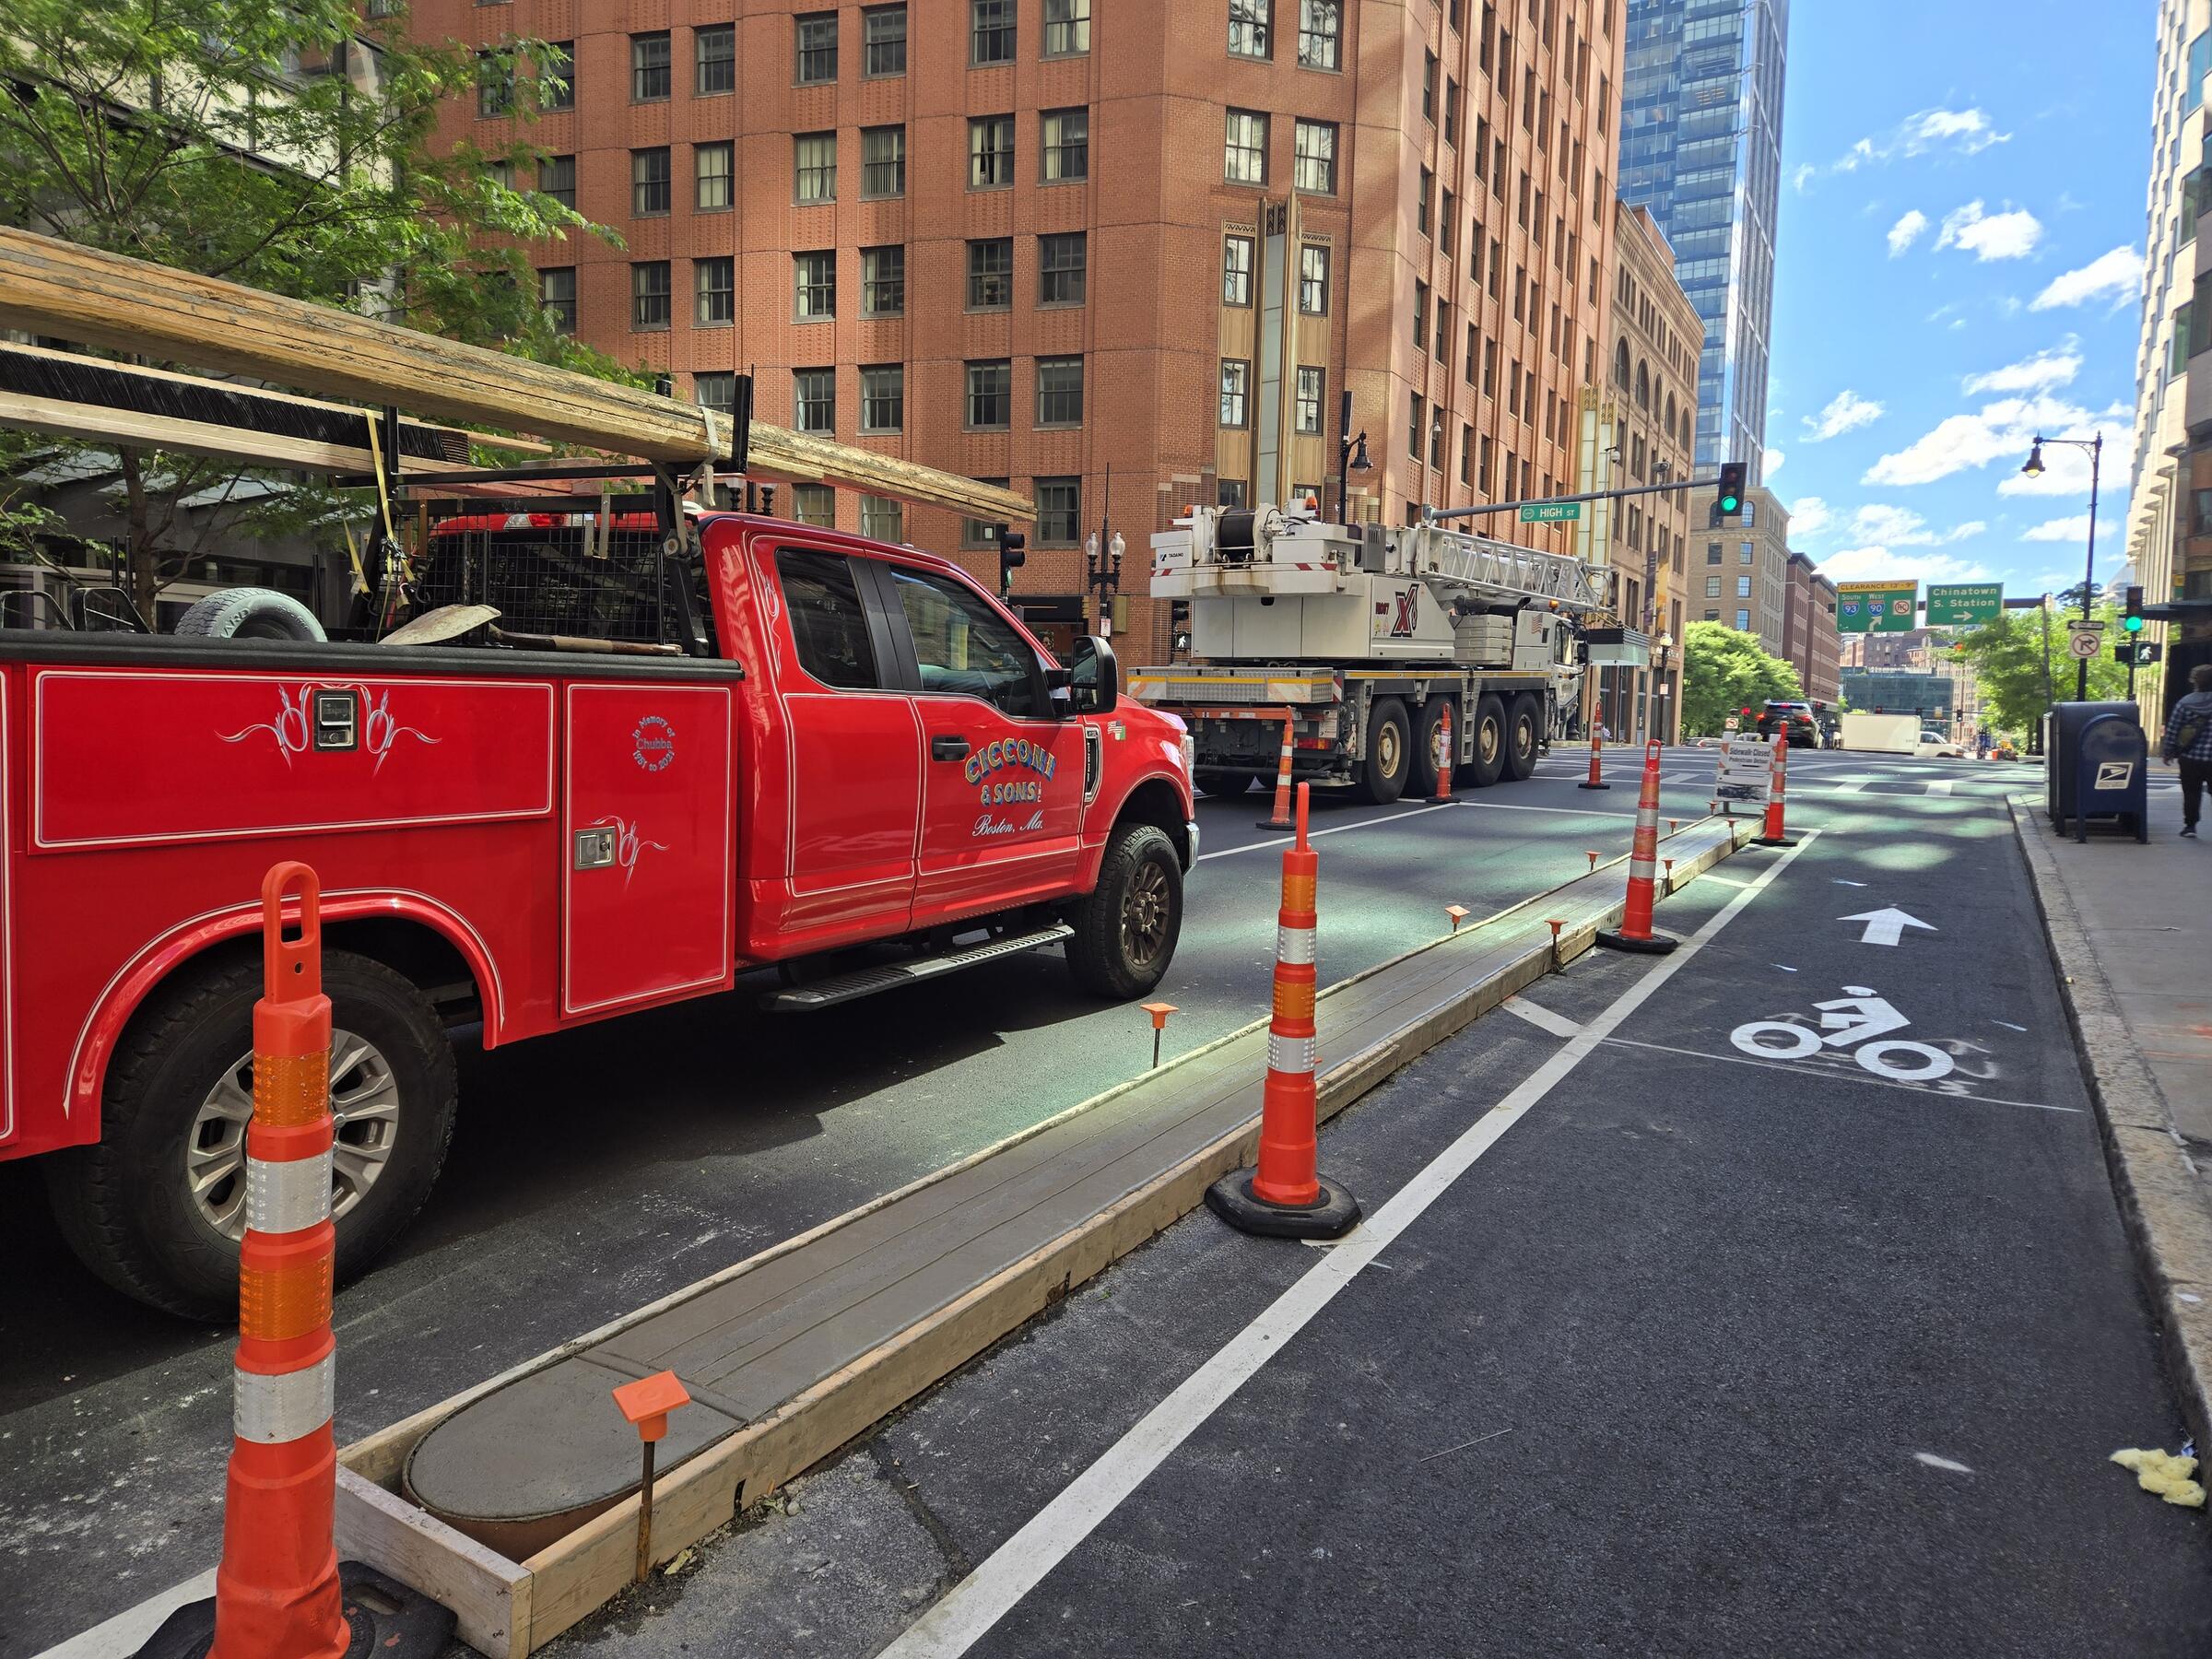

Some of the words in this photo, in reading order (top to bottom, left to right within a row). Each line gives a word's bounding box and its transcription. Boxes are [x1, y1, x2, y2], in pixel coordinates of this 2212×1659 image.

[1539, 508, 1562, 517] HIGH
[1840, 582, 1886, 591] CLEARANCE
[1933, 587, 1997, 596] Chinatown
[1949, 599, 1995, 607] Station
[1844, 605, 1857, 613] 93
[639, 716, 668, 729] Memory
[666, 727, 676, 737] of
[1729, 747, 1752, 756] Sidewalk
[1753, 748, 1771, 758] Closed
[648, 763, 658, 771] to
[981, 784, 991, 806] &
[994, 782, 1036, 805] SONS
[1019, 810, 1045, 830] Ma.
